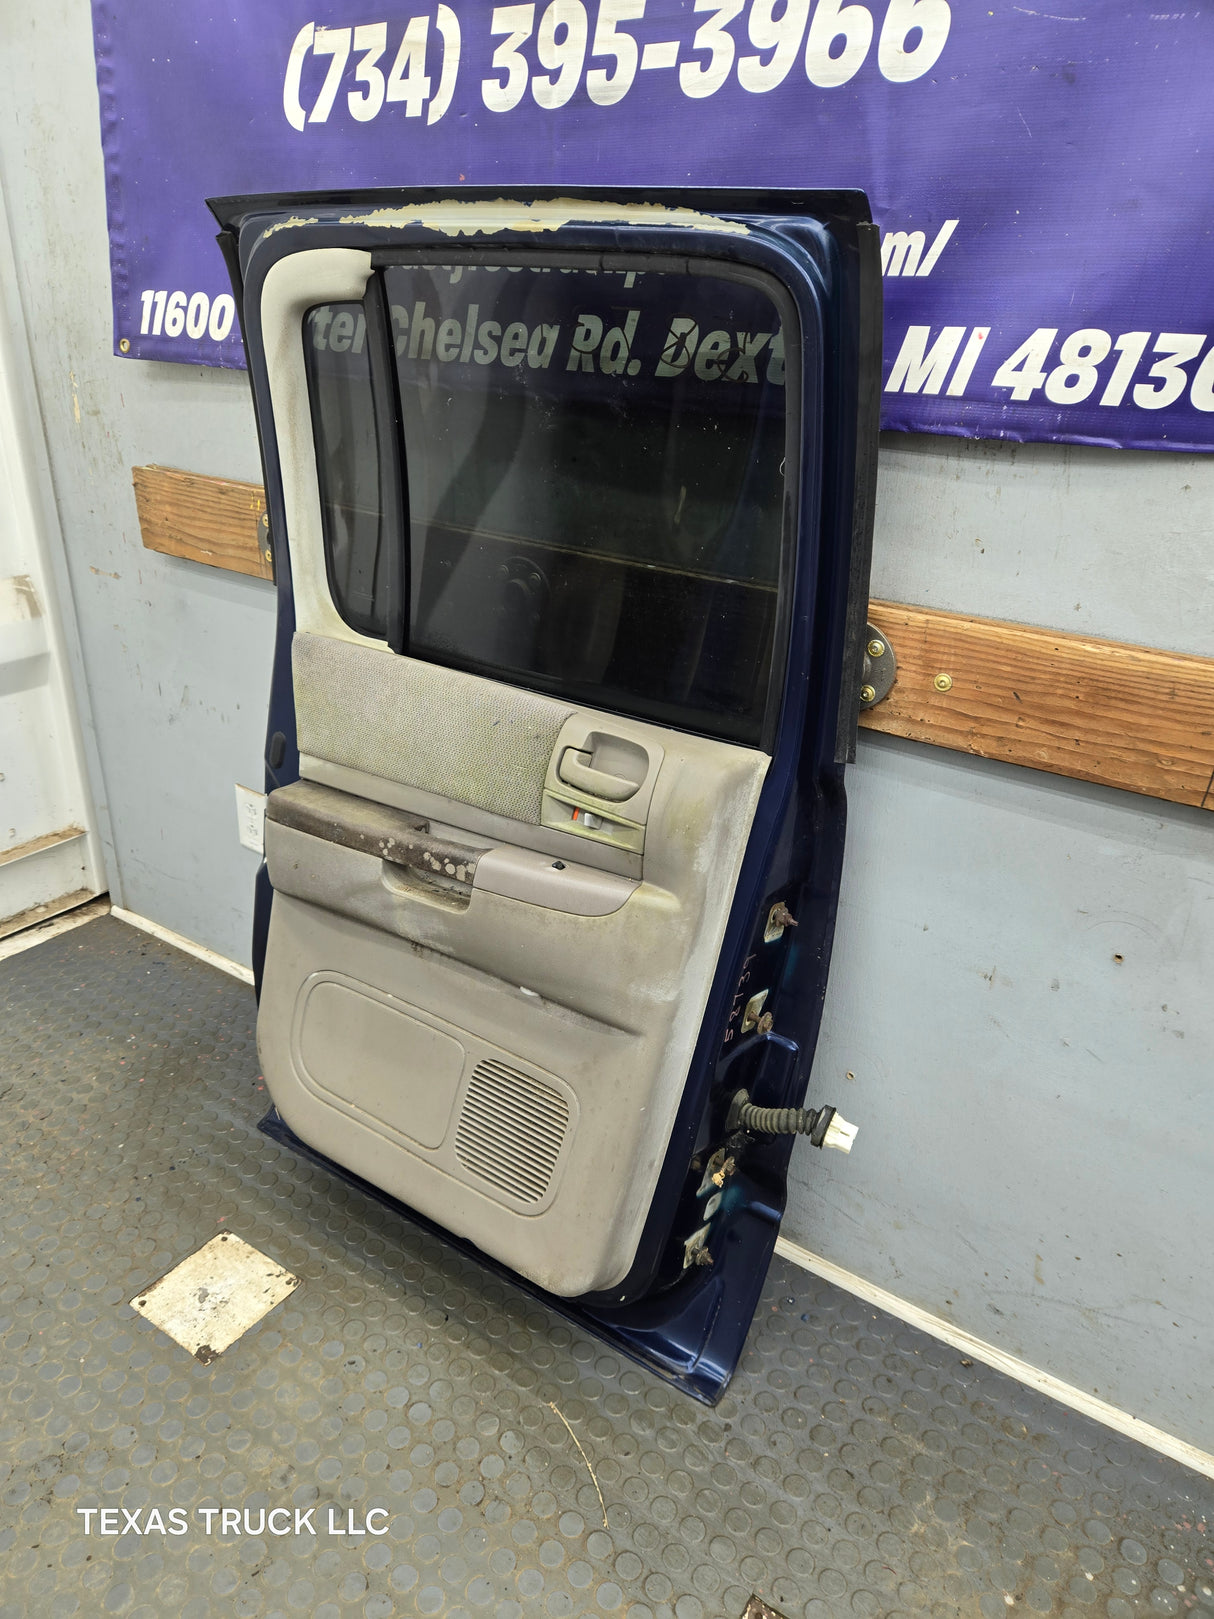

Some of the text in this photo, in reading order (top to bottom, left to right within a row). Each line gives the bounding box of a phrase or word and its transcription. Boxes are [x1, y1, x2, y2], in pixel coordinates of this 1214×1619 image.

[283, 0, 952, 131] (734) 395-3966
[880, 219, 960, 276] m/
[140, 289, 235, 342] 11600
[566, 309, 642, 377] Rd.
[654, 317, 786, 385] Dext
[885, 325, 991, 396] MI
